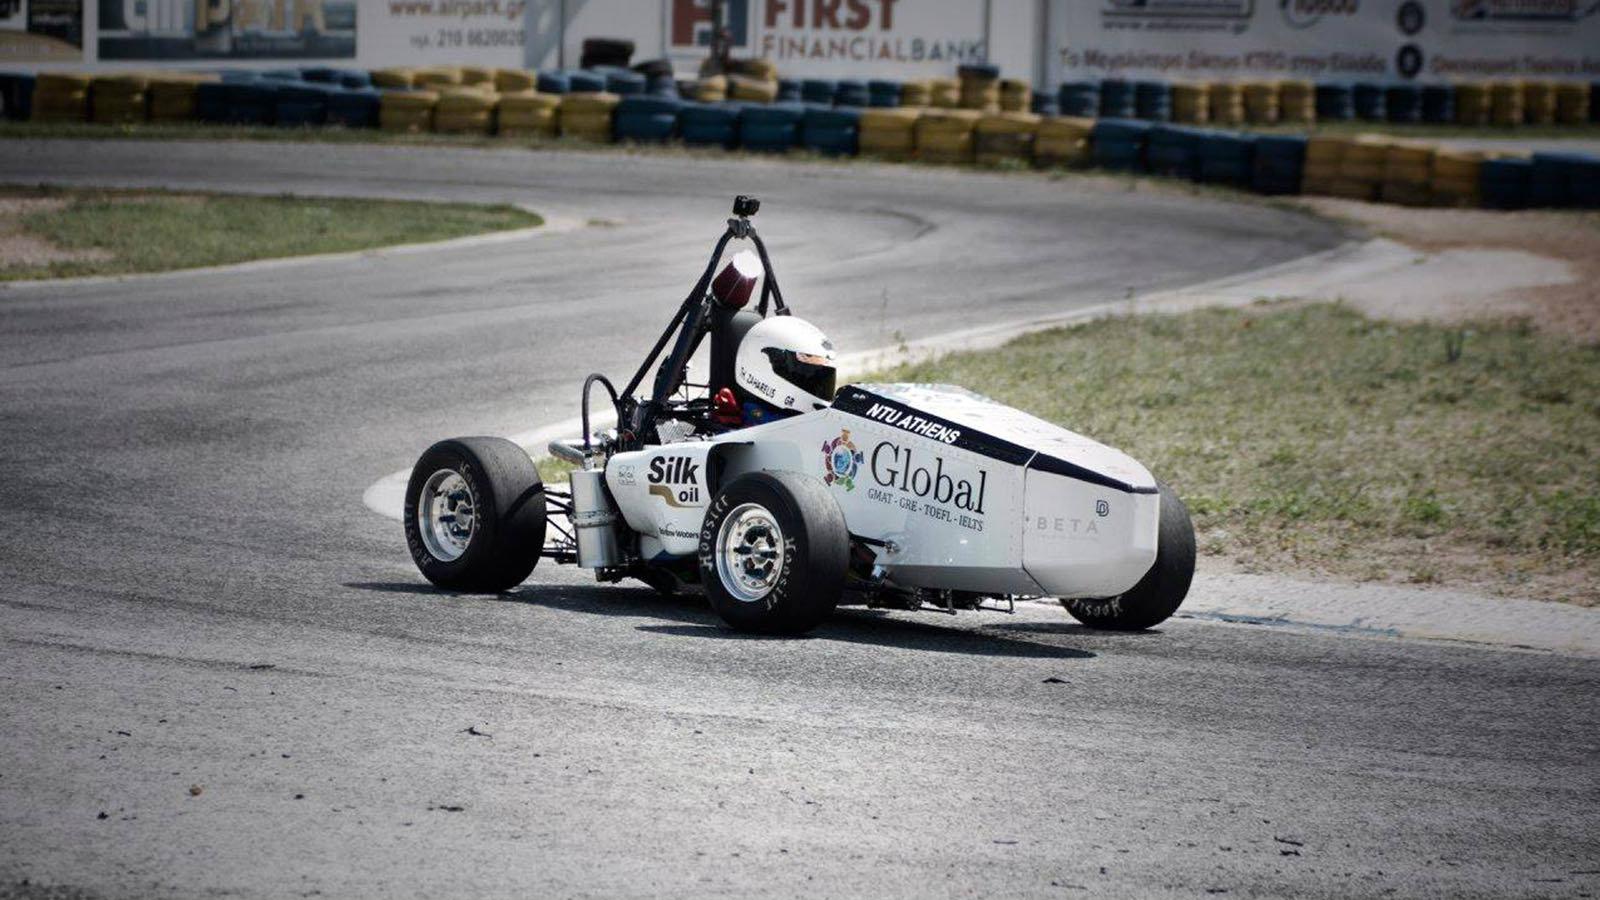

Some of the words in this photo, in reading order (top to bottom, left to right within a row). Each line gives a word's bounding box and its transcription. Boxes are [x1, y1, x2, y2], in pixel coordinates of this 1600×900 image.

[765, 0, 899, 30] FIRST
[866, 403, 900, 424] NTU
[898, 414, 960, 444] ATHENS
[648, 455, 700, 485] Silk
[871, 441, 987, 515] Global
[678, 487, 700, 502] oil
[868, 488, 894, 504] GMAT
[899, 496, 918, 513] GRE
[924, 503, 953, 523] TOEFL
[958, 515, 983, 532] IELTS
[1037, 516, 1098, 533] BETA
